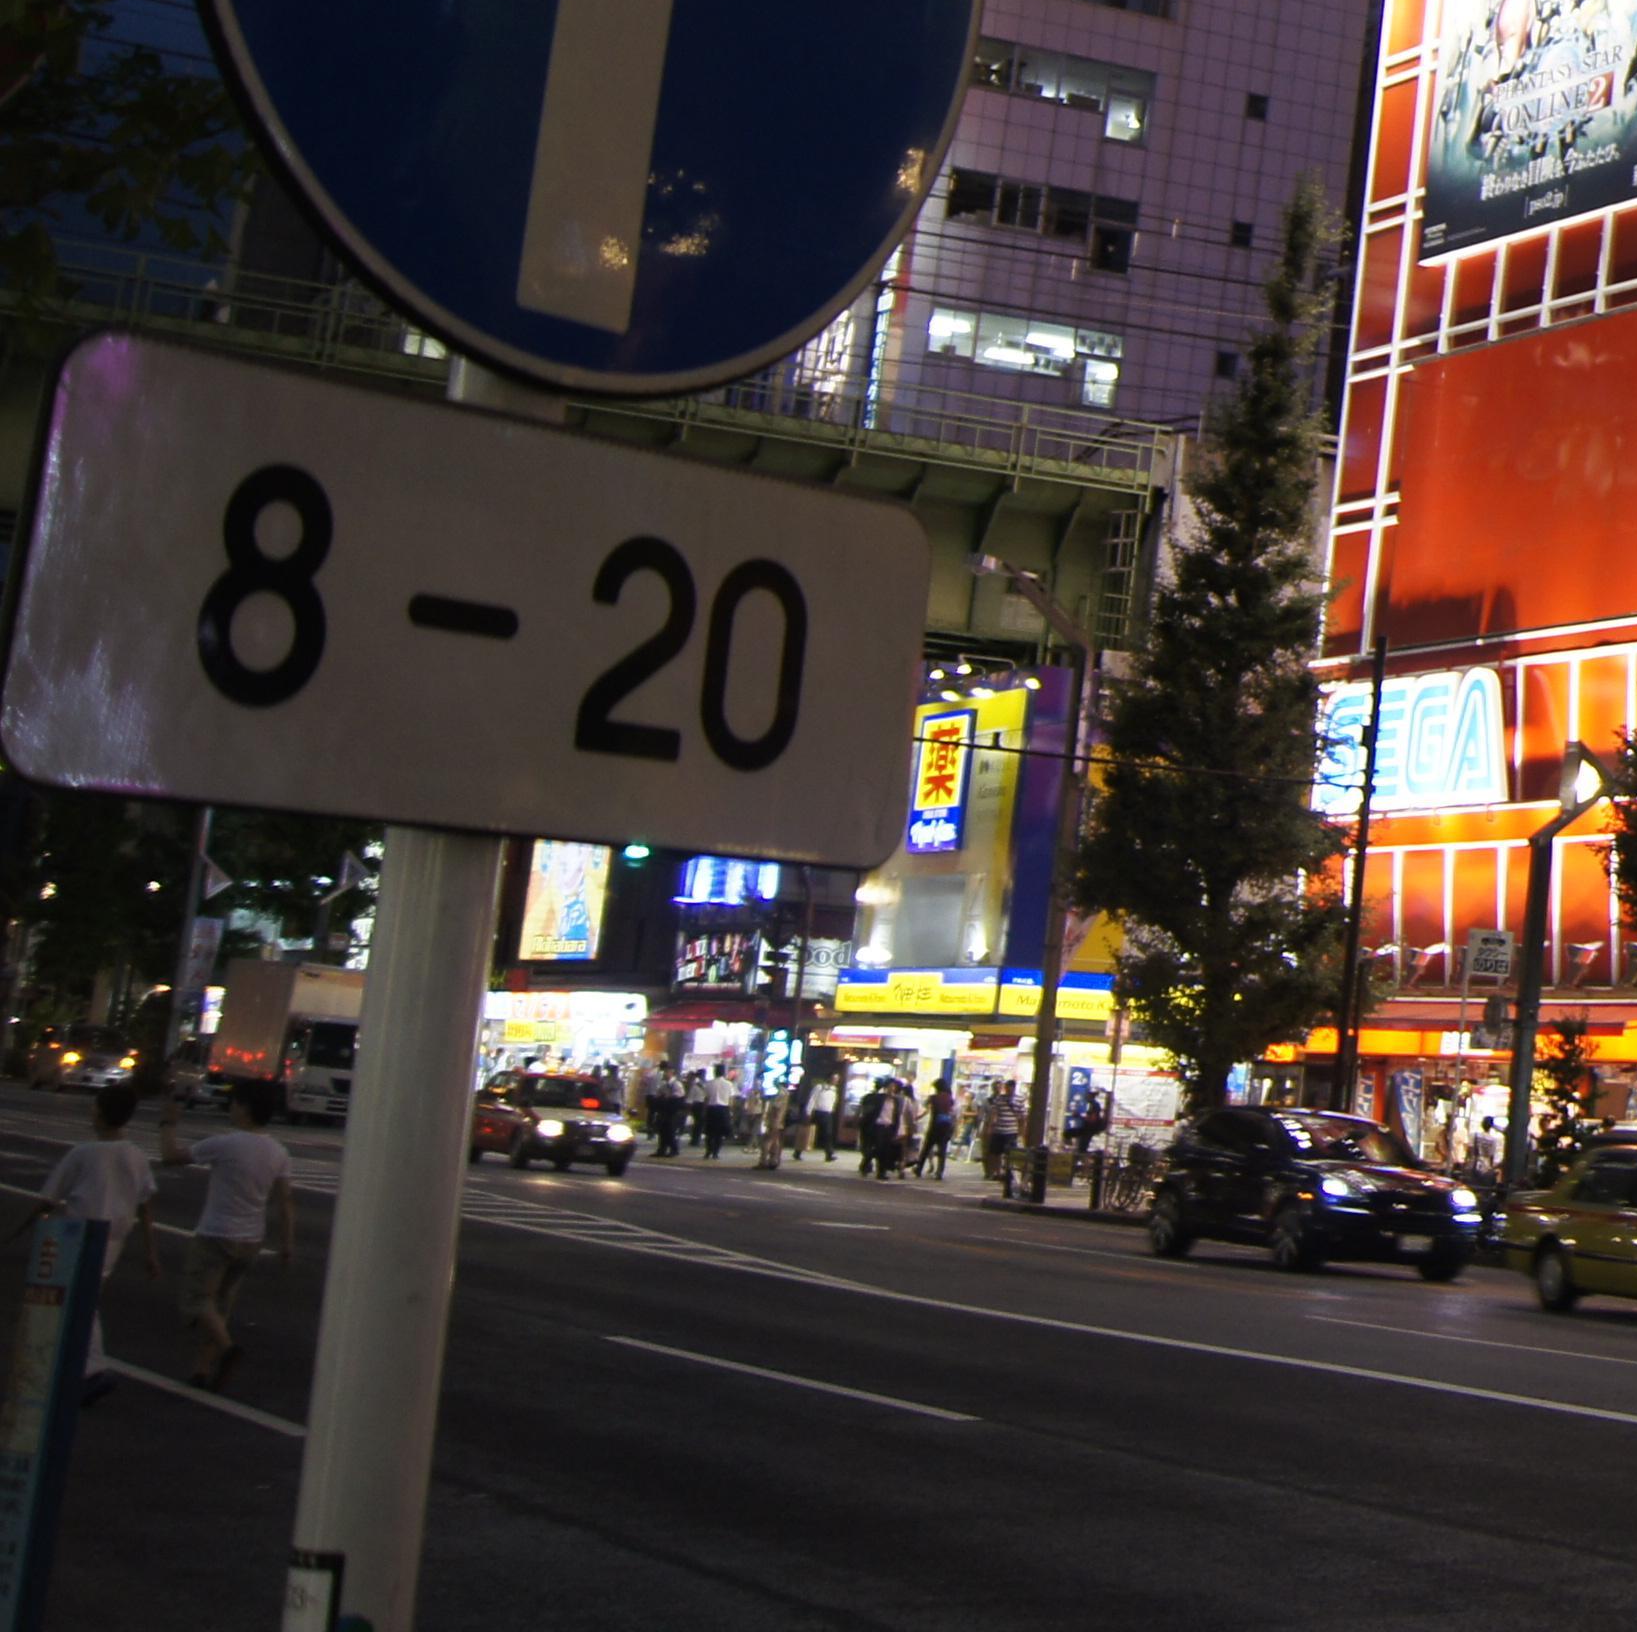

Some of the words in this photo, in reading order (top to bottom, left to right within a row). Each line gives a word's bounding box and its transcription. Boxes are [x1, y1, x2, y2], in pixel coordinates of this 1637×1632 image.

[1583, 44, 1623, 70] STAR
[1505, 82, 1589, 132] ONLINE
[922, 722, 961, 803] 薬
[1312, 665, 1509, 820] SEGA
